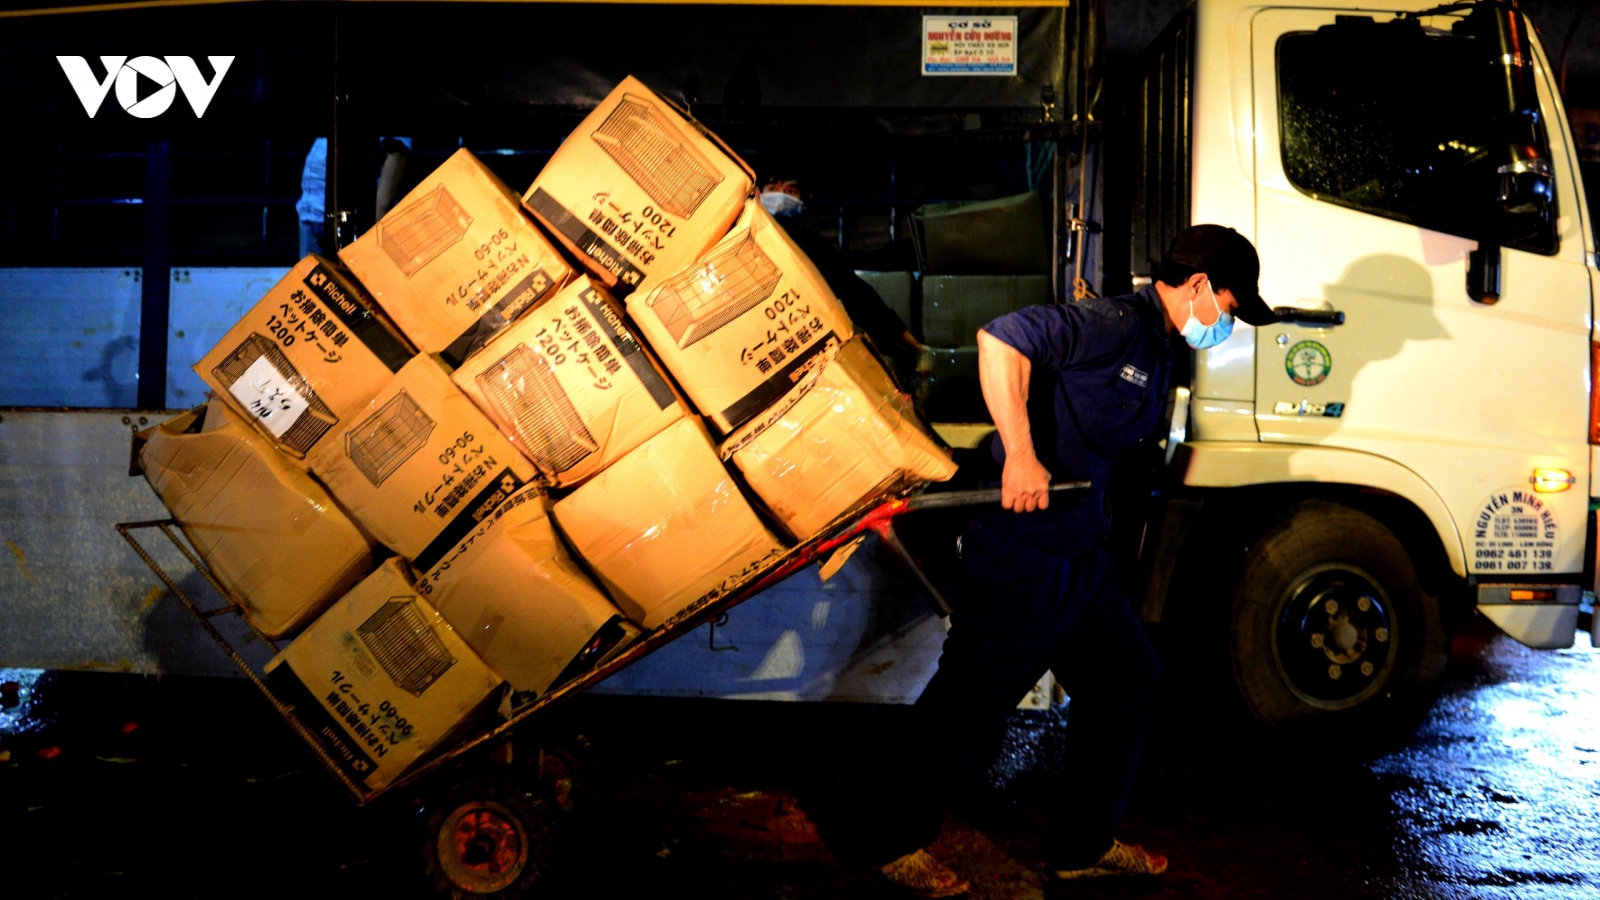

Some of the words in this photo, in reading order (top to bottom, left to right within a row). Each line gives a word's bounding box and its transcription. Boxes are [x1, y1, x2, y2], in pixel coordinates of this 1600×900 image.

[642, 205, 677, 239] 1200
[474, 228, 509, 261] 90-60
[586, 243, 624, 276] Richell
[323, 282, 357, 316] Richell
[500, 287, 536, 321] Richell
[764, 288, 800, 320] 1200
[266, 315, 295, 347] 1200
[290, 289, 349, 348] お掃除簡単
[535, 327, 567, 366] 1200
[564, 305, 622, 376] お掃除簡単
[438, 431, 474, 465] 90-60
[471, 489, 506, 522] Richell
[1511, 506, 1523, 514] 3N
[1513, 491, 1544, 511] MINH
[1475, 561, 1502, 570] 0961
[1507, 561, 1527, 570] 007
[1476, 550, 1504, 559] 0962
[1533, 550, 1552, 559] 139
[379, 700, 414, 736] 90-60
[321, 726, 354, 761] Richell
